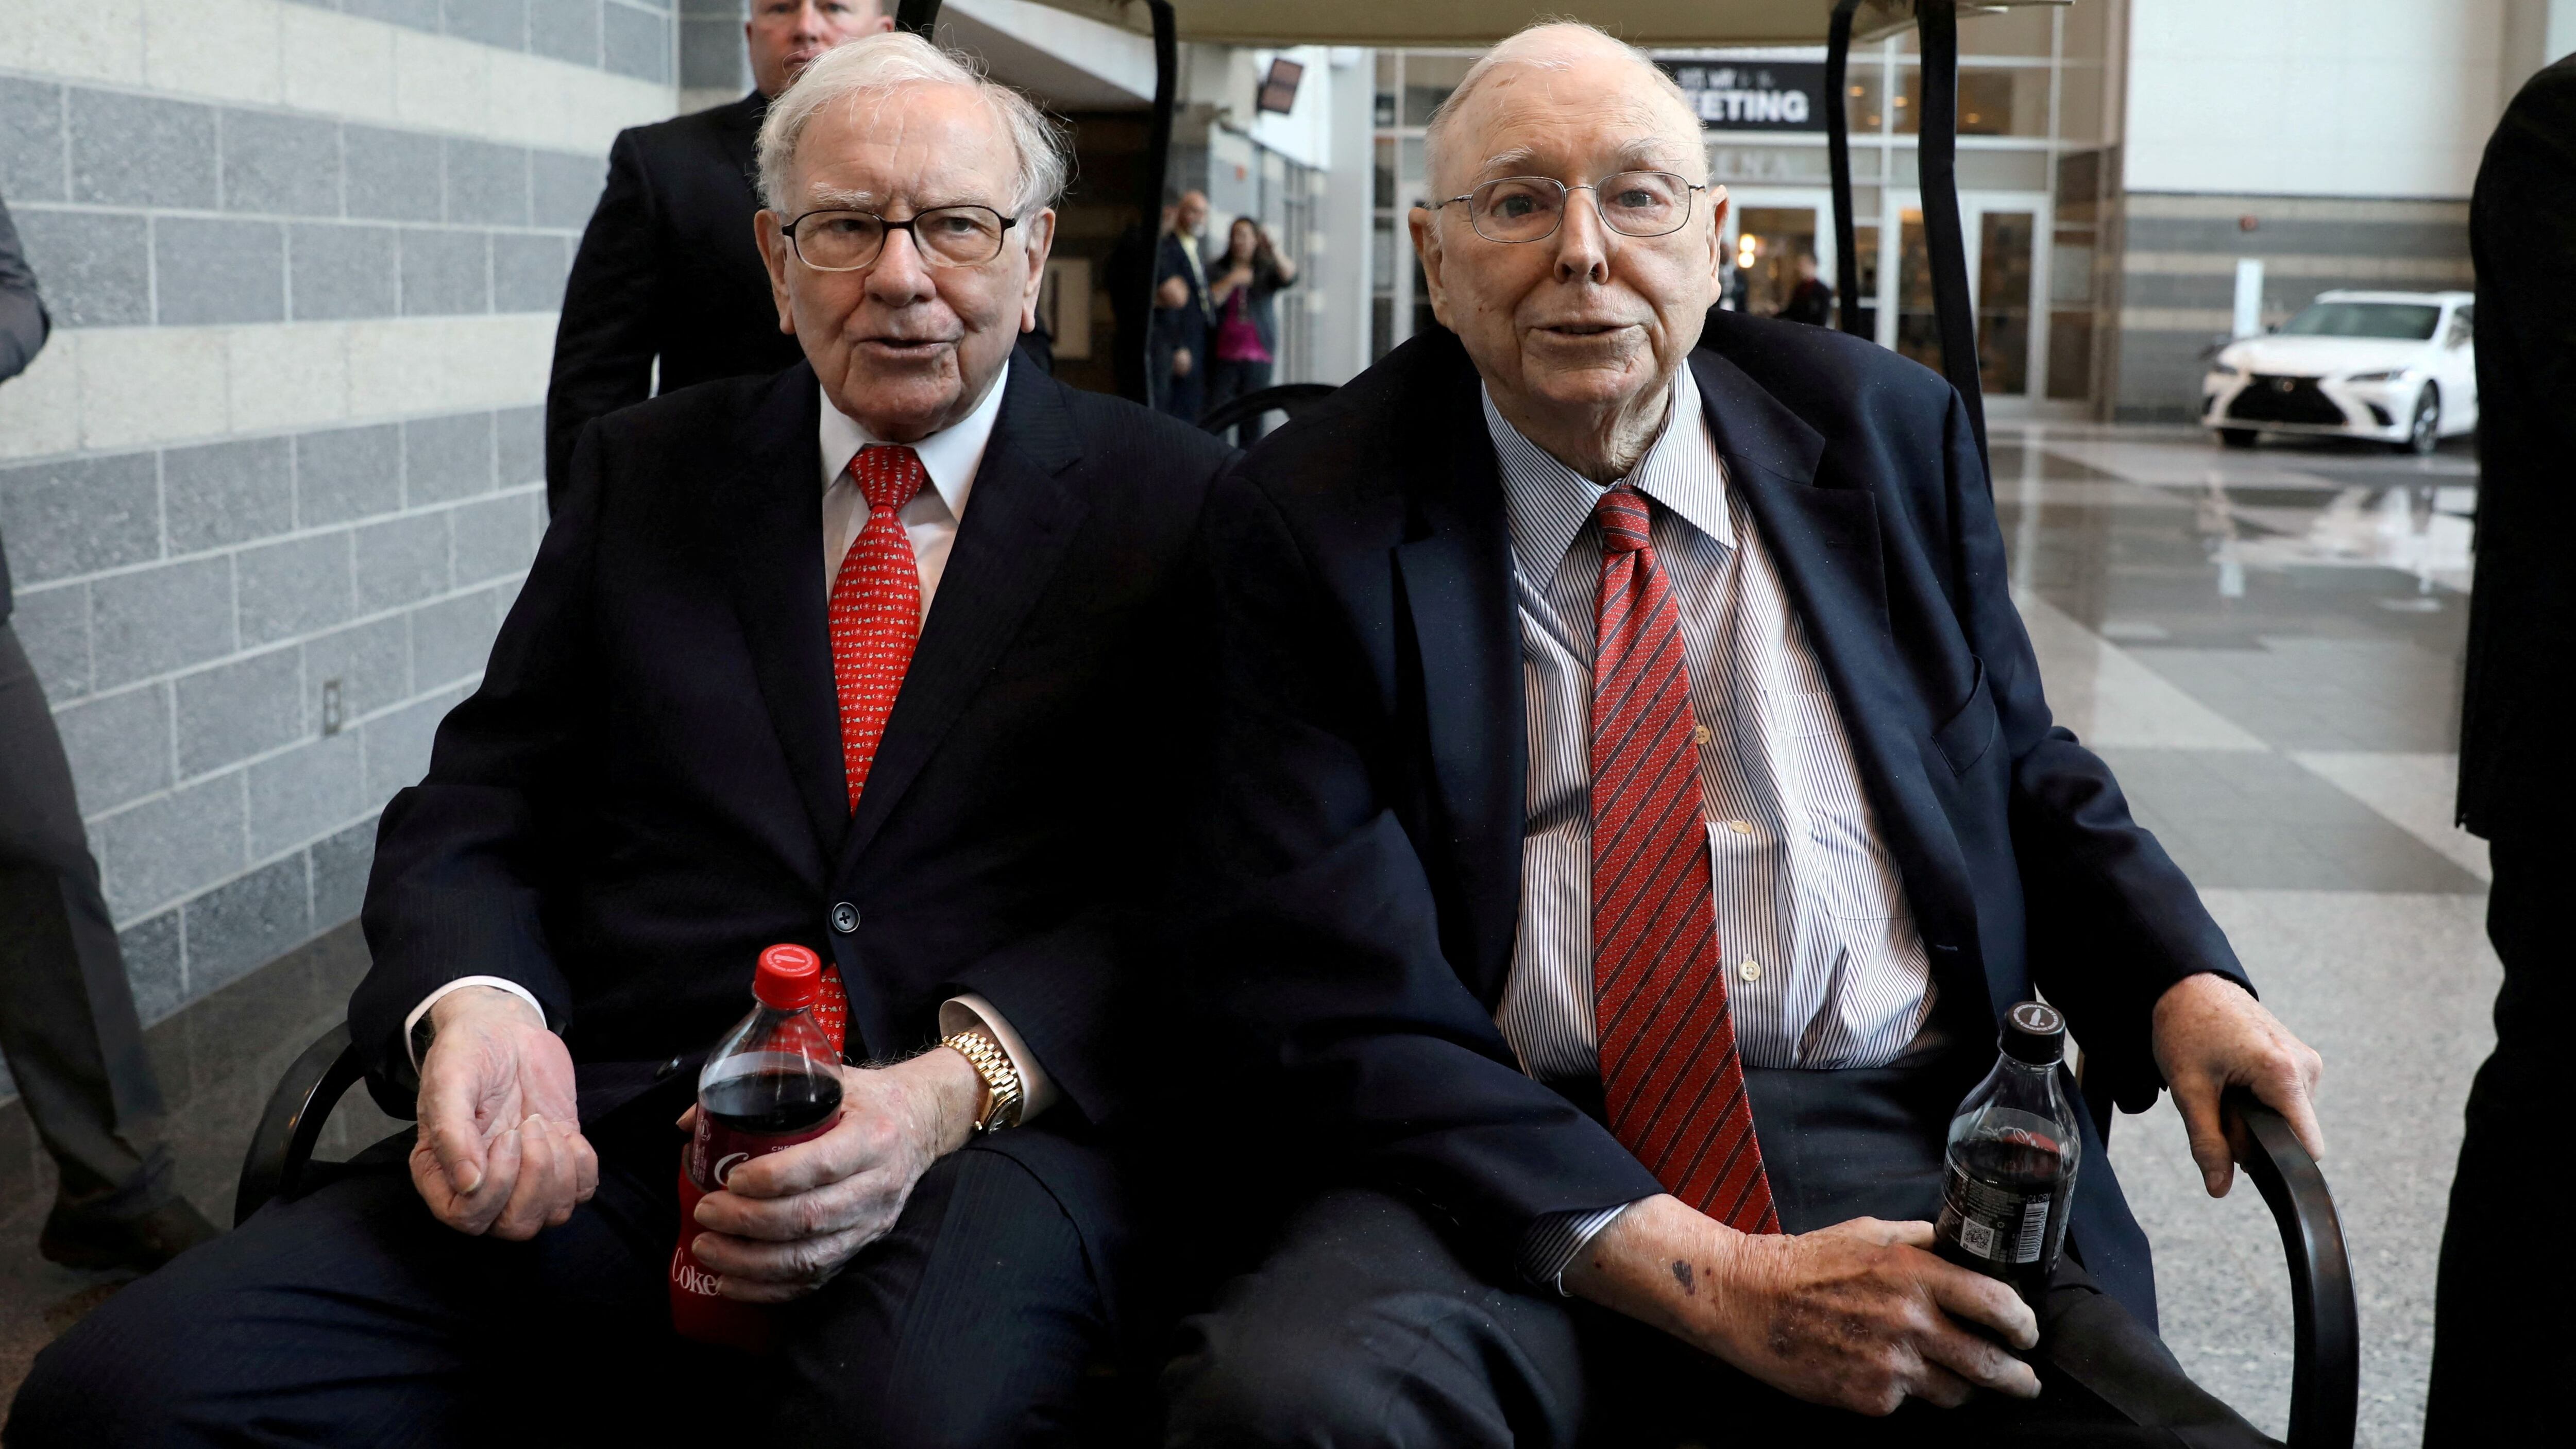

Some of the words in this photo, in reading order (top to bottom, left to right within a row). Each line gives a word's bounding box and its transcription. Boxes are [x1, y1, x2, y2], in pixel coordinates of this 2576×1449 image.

[2027, 1195, 2036, 1203] CA
[2038, 1192, 2052, 1203] CRV
[672, 1246, 719, 1296] Coke
